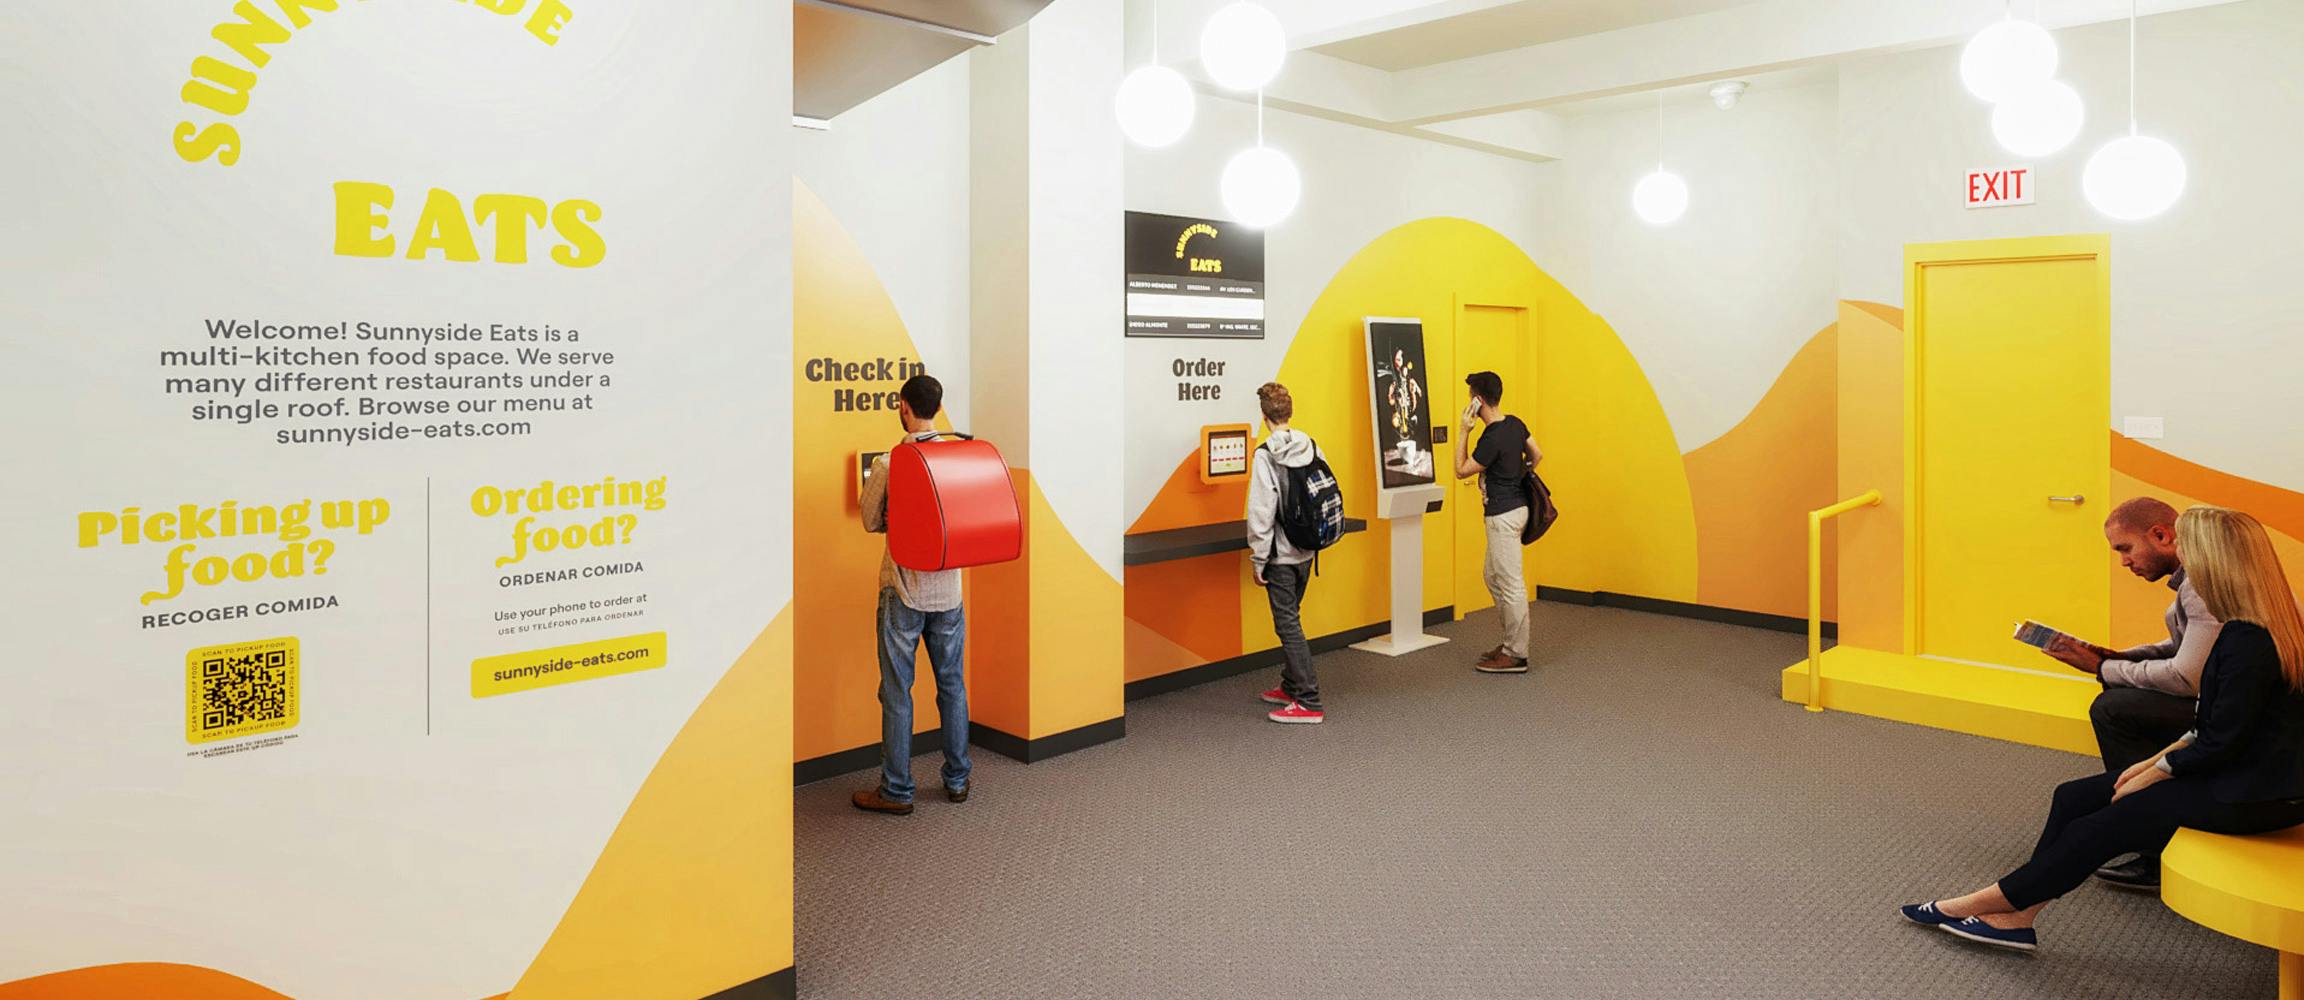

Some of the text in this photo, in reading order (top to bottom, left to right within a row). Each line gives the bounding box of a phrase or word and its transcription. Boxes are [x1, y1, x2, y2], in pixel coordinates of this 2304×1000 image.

[1969, 169, 2027, 202] EXIT
[333, 181, 607, 268] EATS
[1175, 223, 1218, 259] SUNNYSIDE
[1190, 258, 1222, 273] EATS
[205, 318, 579, 346] Welcome! Sunnyside Eats is a
[161, 346, 615, 370] multi-kitchen food space. We serve
[805, 357, 925, 382] Check in
[1172, 357, 1226, 378] Order
[166, 371, 611, 398] many different restaurants under a
[1178, 382, 1222, 402] Here
[192, 394, 593, 425] single roof. Browse our menu at
[833, 389, 901, 412] Here
[276, 420, 531, 447] sunnyside-eats.com
[470, 475, 667, 517] Ordering
[78, 498, 391, 548] Picking up
[495, 513, 638, 568] food?
[140, 539, 335, 606] food?
[499, 561, 644, 588] ORDENAR COMIDA
[142, 595, 339, 629] RECOGER COMIDA
[494, 594, 647, 622] Use your phone to order at
[498, 610, 644, 635] USE SU TELÉFONO PARA ORDENAR
[236, 644, 264, 653] PICKUP
[494, 648, 649, 682] sunnyside-eats.com
[202, 731, 222, 739] SCAN
[236, 724, 264, 733] PICKUP
